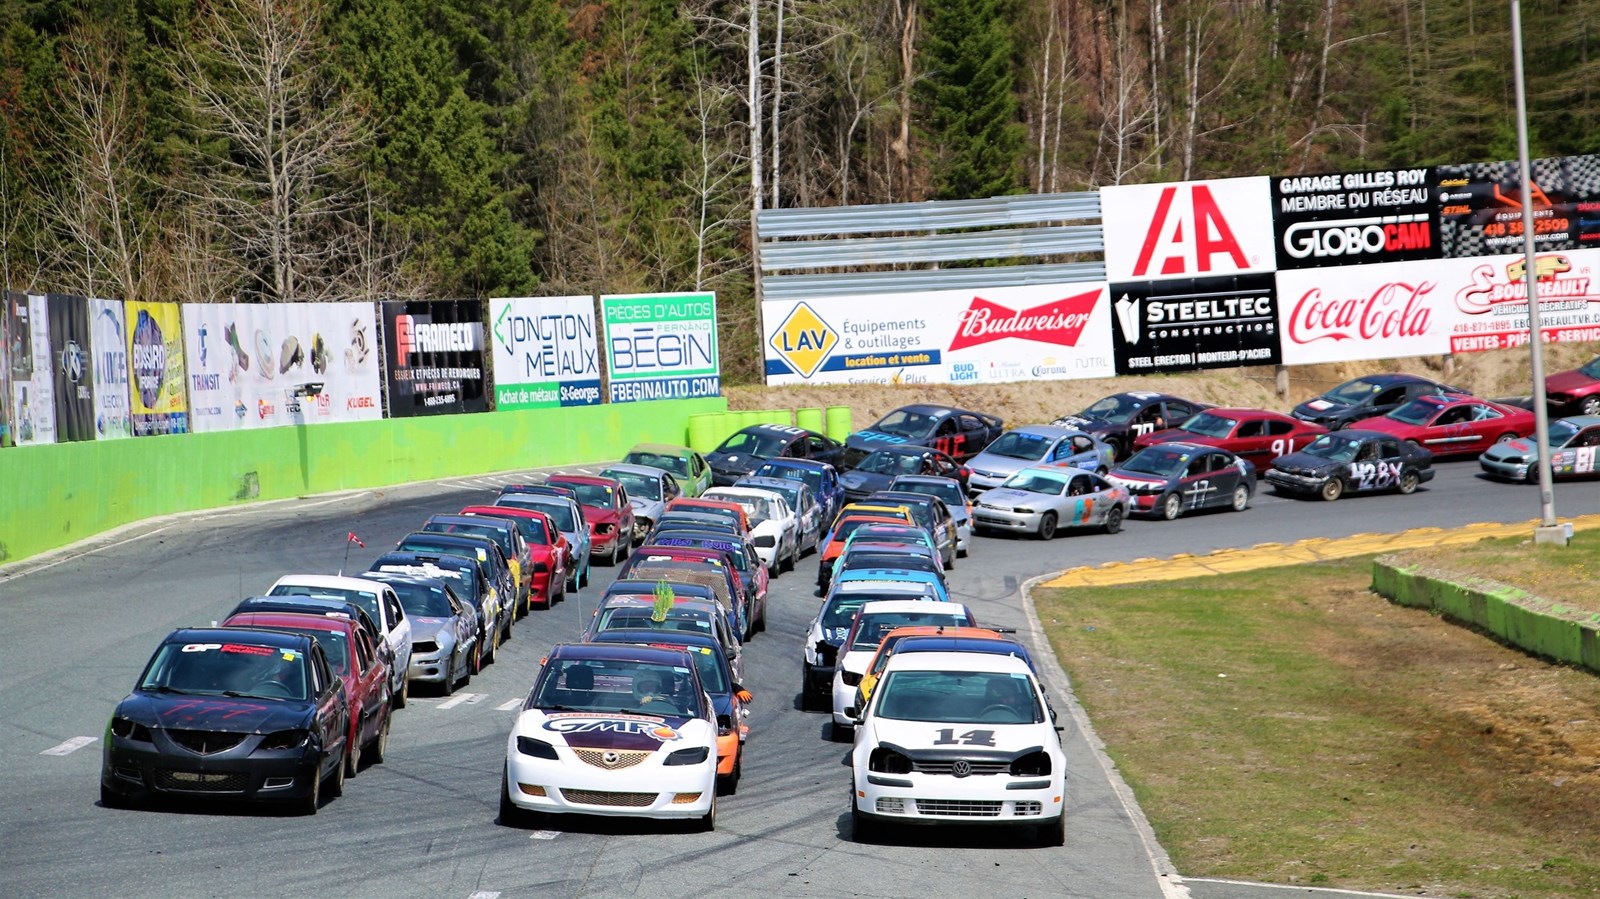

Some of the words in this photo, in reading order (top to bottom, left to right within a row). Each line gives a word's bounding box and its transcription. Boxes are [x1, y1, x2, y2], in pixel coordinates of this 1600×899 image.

[1280, 175, 1342, 194] GARAGE
[1343, 171, 1394, 189] GILLES
[1397, 168, 1428, 185] ROY
[1281, 194, 1347, 213] MEMBRE
[1348, 192, 1370, 208] DU
[1373, 187, 1428, 206] RÉSEAU
[1485, 224, 1506, 235] 418
[1508, 218, 1569, 233] 38-2509
[607, 304, 651, 320] PIÈCES
[654, 302, 711, 318] D'AUTOS
[1146, 297, 1272, 323] STEELTEC
[1288, 280, 1439, 344] Coca-Cola
[1539, 300, 1588, 311] RÉCRÉATIFS
[656, 322, 709, 332] FERNAND
[843, 319, 926, 335] Équipements
[958, 306, 1090, 337] Budweiser
[1453, 320, 1511, 332] 418-871-1895
[415, 323, 474, 353] FRAMECO
[1148, 322, 1274, 339] CONSTRUCTION
[783, 330, 826, 351] LAV
[845, 340, 853, 349] &
[858, 336, 921, 349] outillages
[1453, 336, 1500, 351] VENTES
[845, 355, 886, 367] location
[888, 354, 899, 363] et
[901, 353, 930, 363] vente
[953, 363, 974, 372] BUD
[1128, 356, 1153, 369] STEEL
[1154, 353, 1191, 366] ERECTOR
[905, 374, 927, 384] Plus
[950, 372, 979, 381] LIGHT
[1031, 365, 1067, 377] Corona
[192, 374, 220, 391] TRANSIT
[611, 378, 718, 401] FBEGINAUTO.COM
[499, 389, 519, 404] Achat
[520, 389, 529, 402] de
[530, 387, 560, 402] métaux
[560, 385, 599, 403] St-Georges
[347, 397, 375, 410] KUGEL
[1271, 438, 1294, 458] 91
[933, 728, 996, 747] 14
